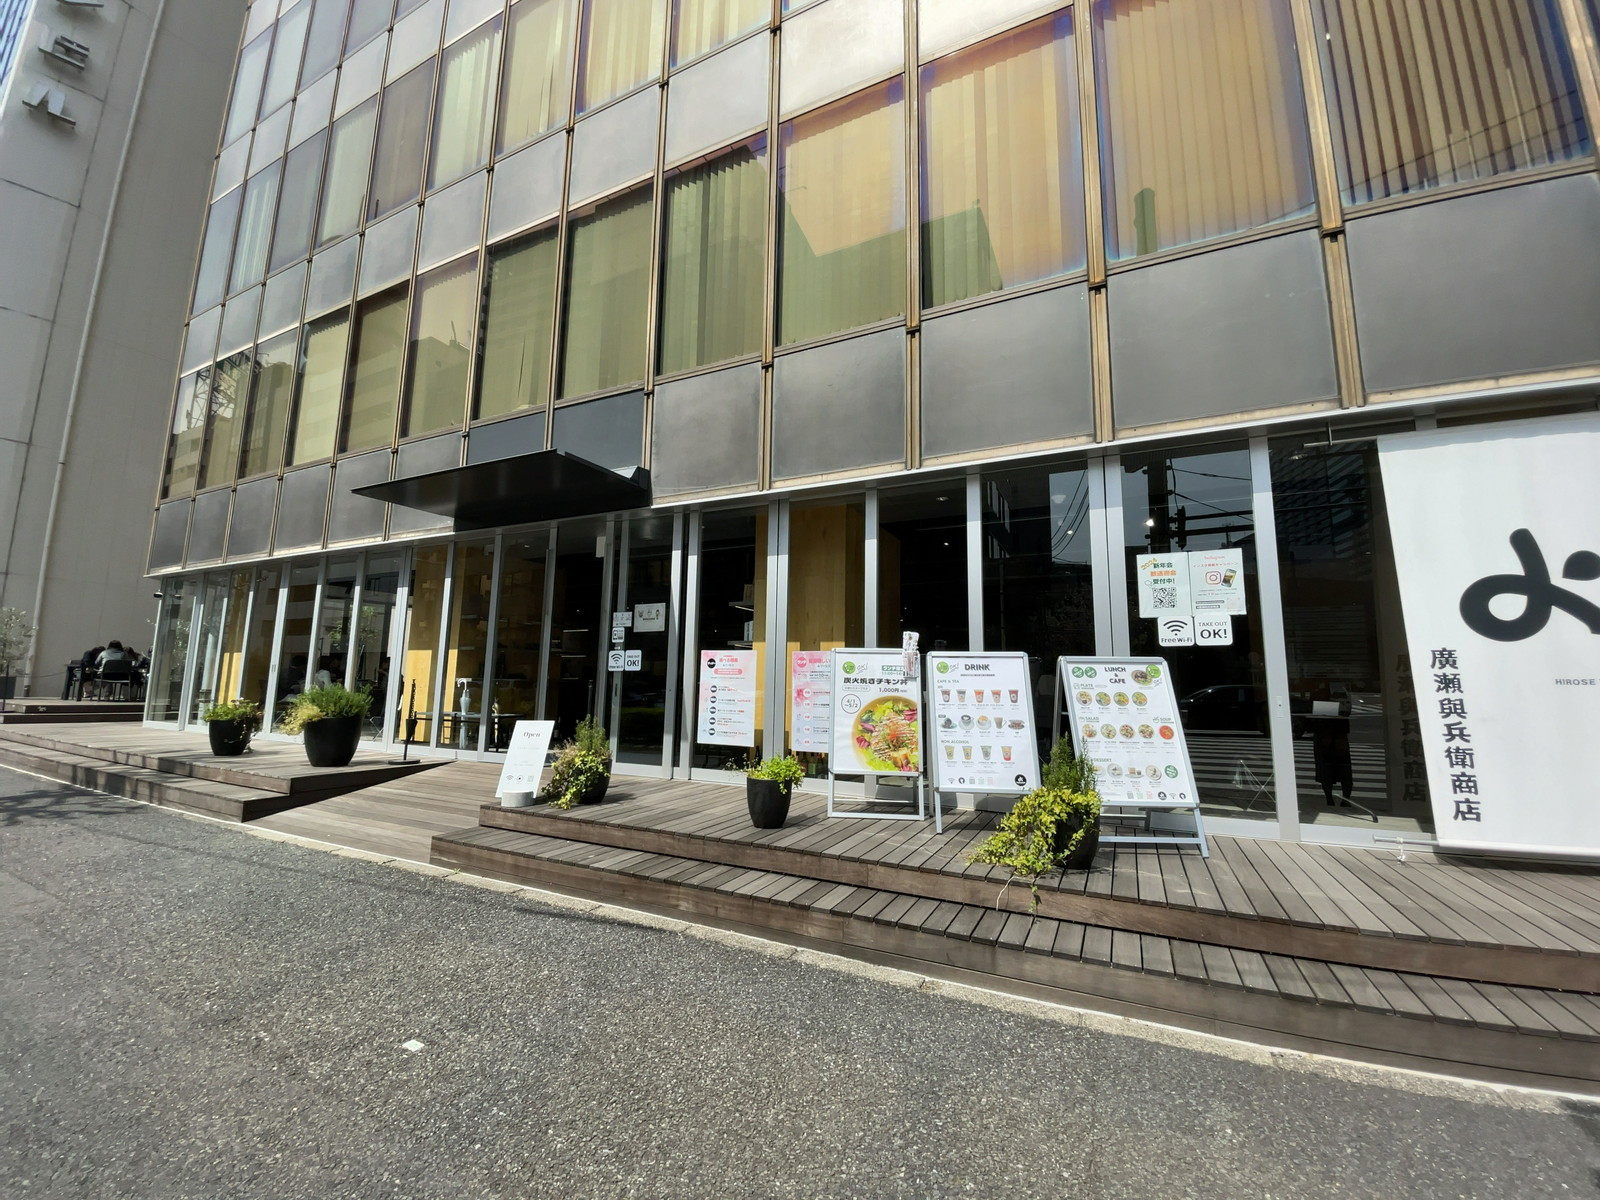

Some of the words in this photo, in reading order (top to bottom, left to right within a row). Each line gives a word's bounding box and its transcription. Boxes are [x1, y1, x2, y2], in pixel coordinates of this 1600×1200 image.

[1200, 629, 1228, 639] OK!
[964, 663, 991, 672] DRINK
[843, 677, 909, 686] 炭火焼きチキン丼
[1555, 678, 1597, 686] HIROSE
